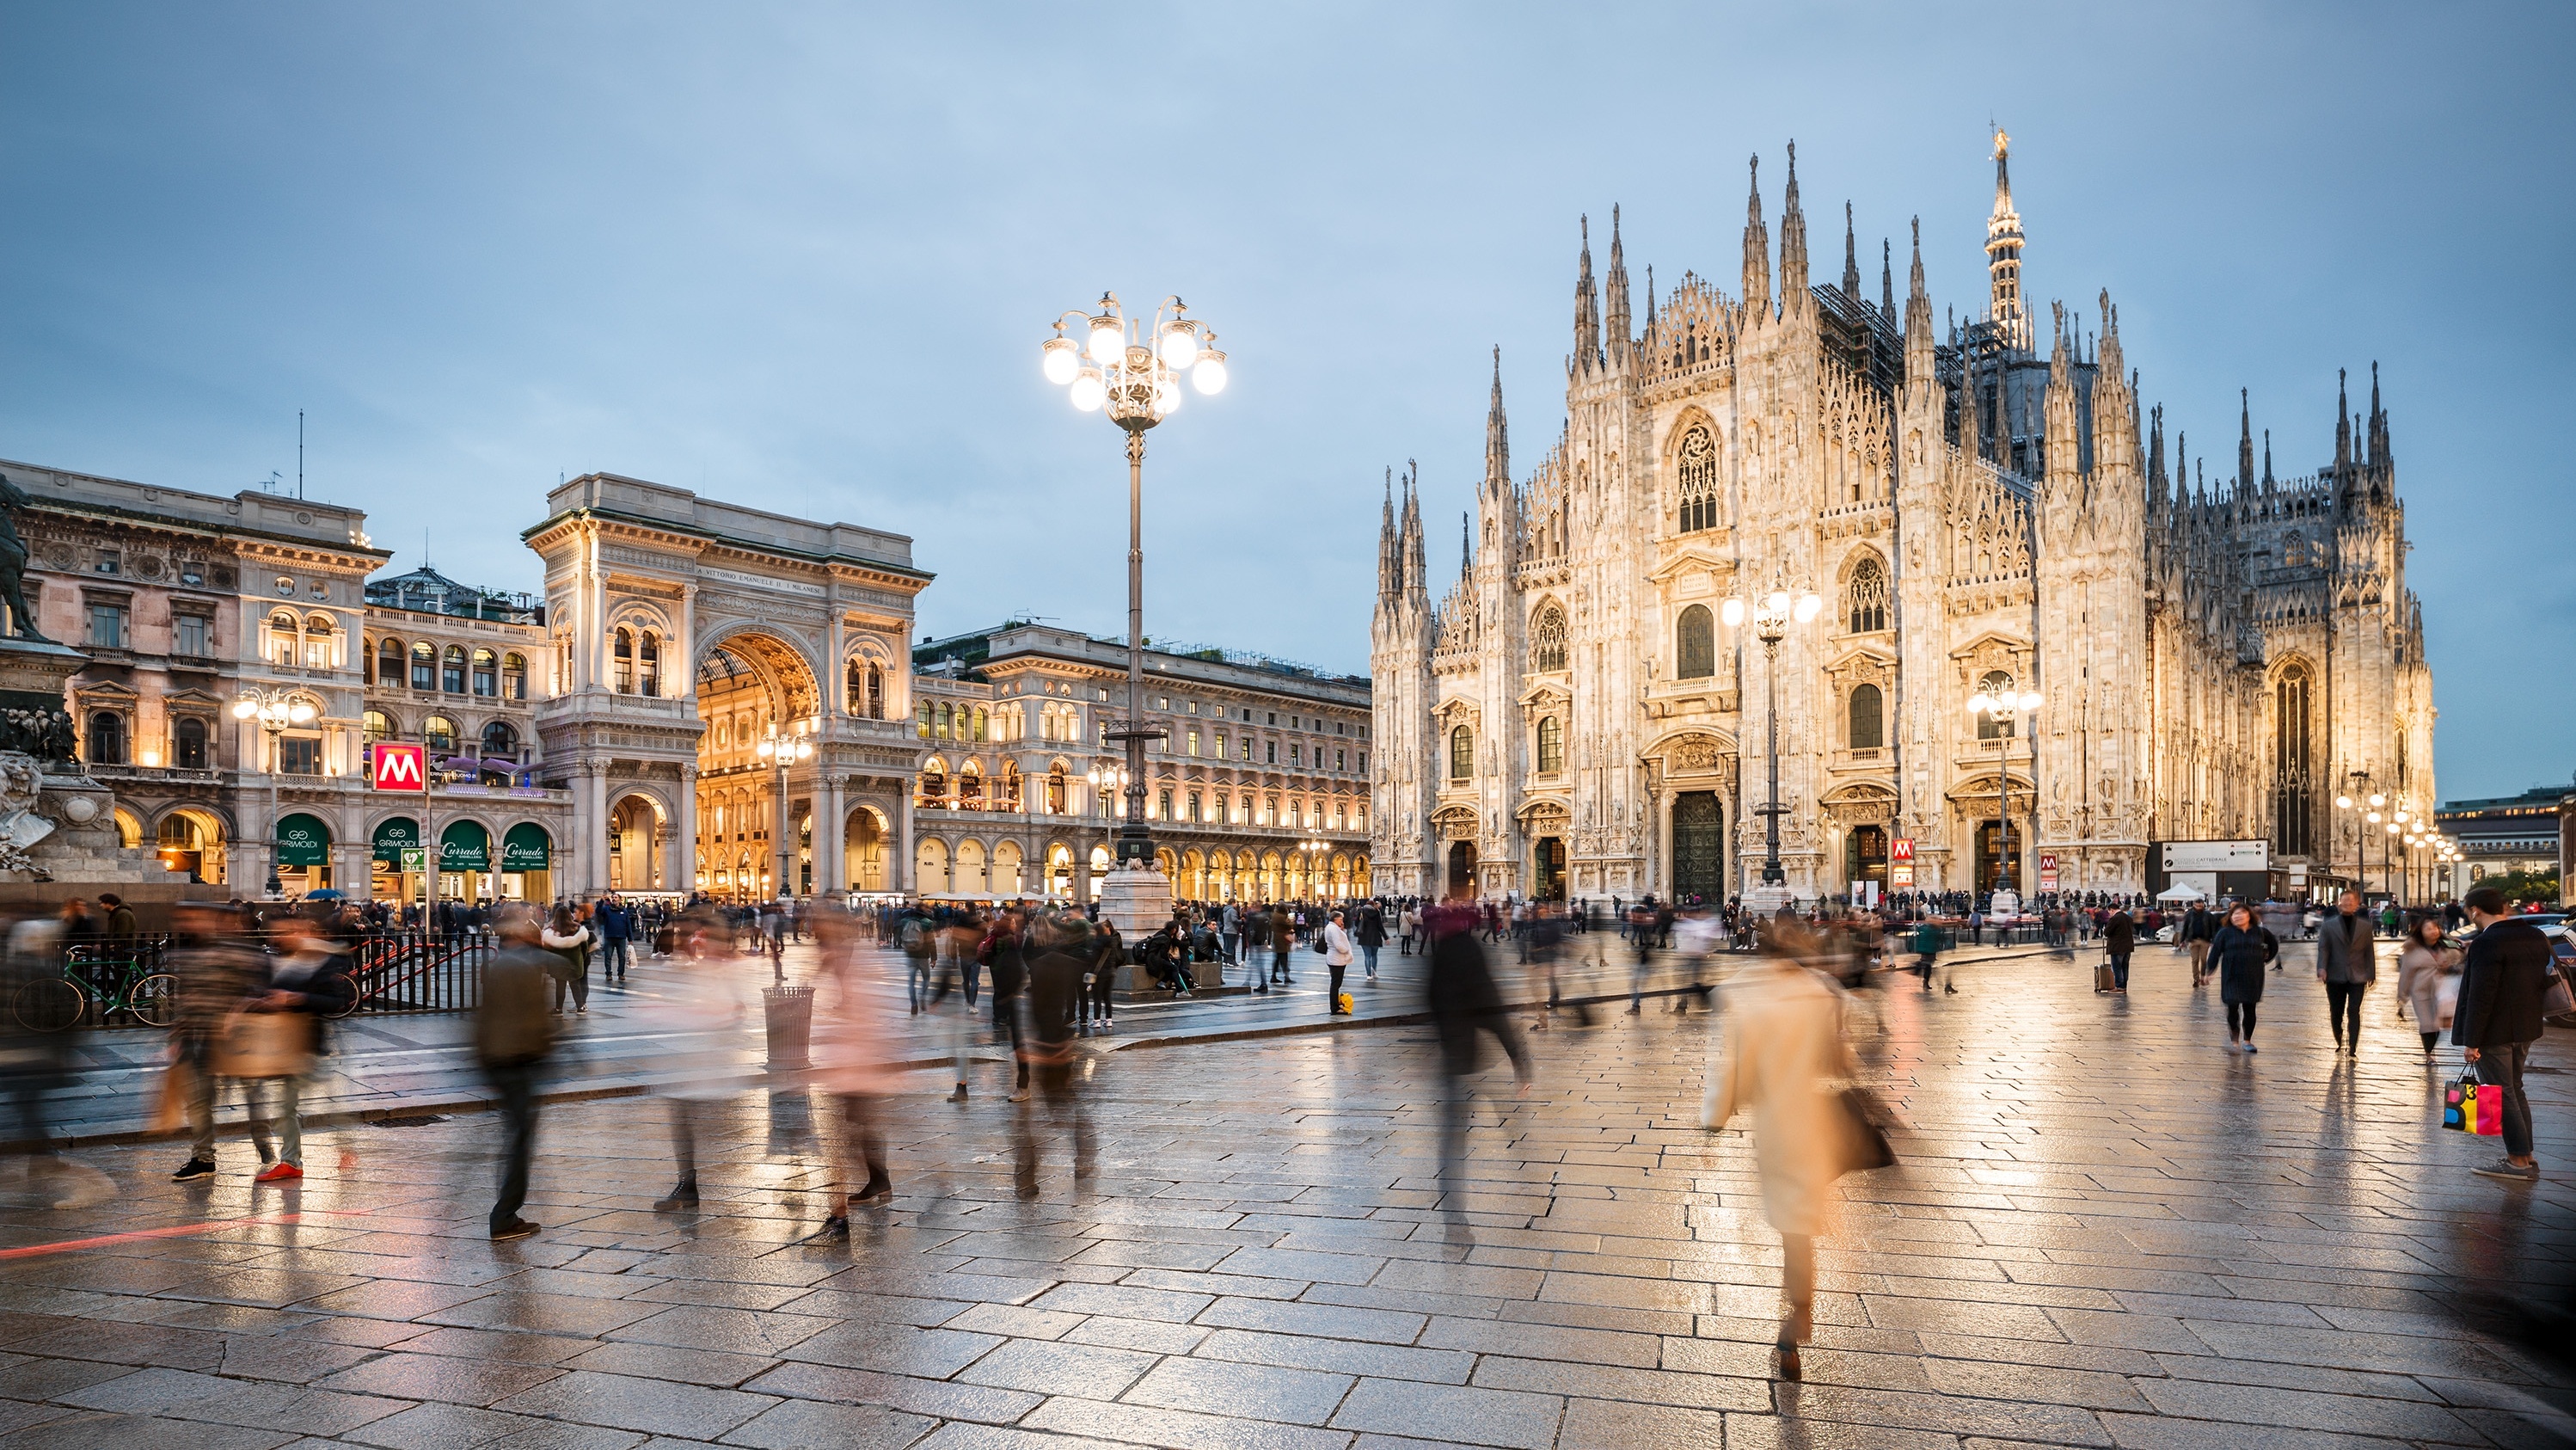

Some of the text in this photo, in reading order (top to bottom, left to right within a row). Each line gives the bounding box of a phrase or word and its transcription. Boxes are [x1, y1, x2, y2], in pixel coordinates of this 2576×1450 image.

[706, 569, 736, 580] VITTORIO
[739, 574, 773, 587] EMANUELE
[792, 584, 820, 594] MILANESI
[378, 753, 421, 783] M
[378, 839, 416, 848] GRIMOLDI
[441, 842, 482, 858] Currado
[505, 842, 543, 858] Currado
[1894, 843, 1911, 857] M
[2042, 857, 2056, 868] M
